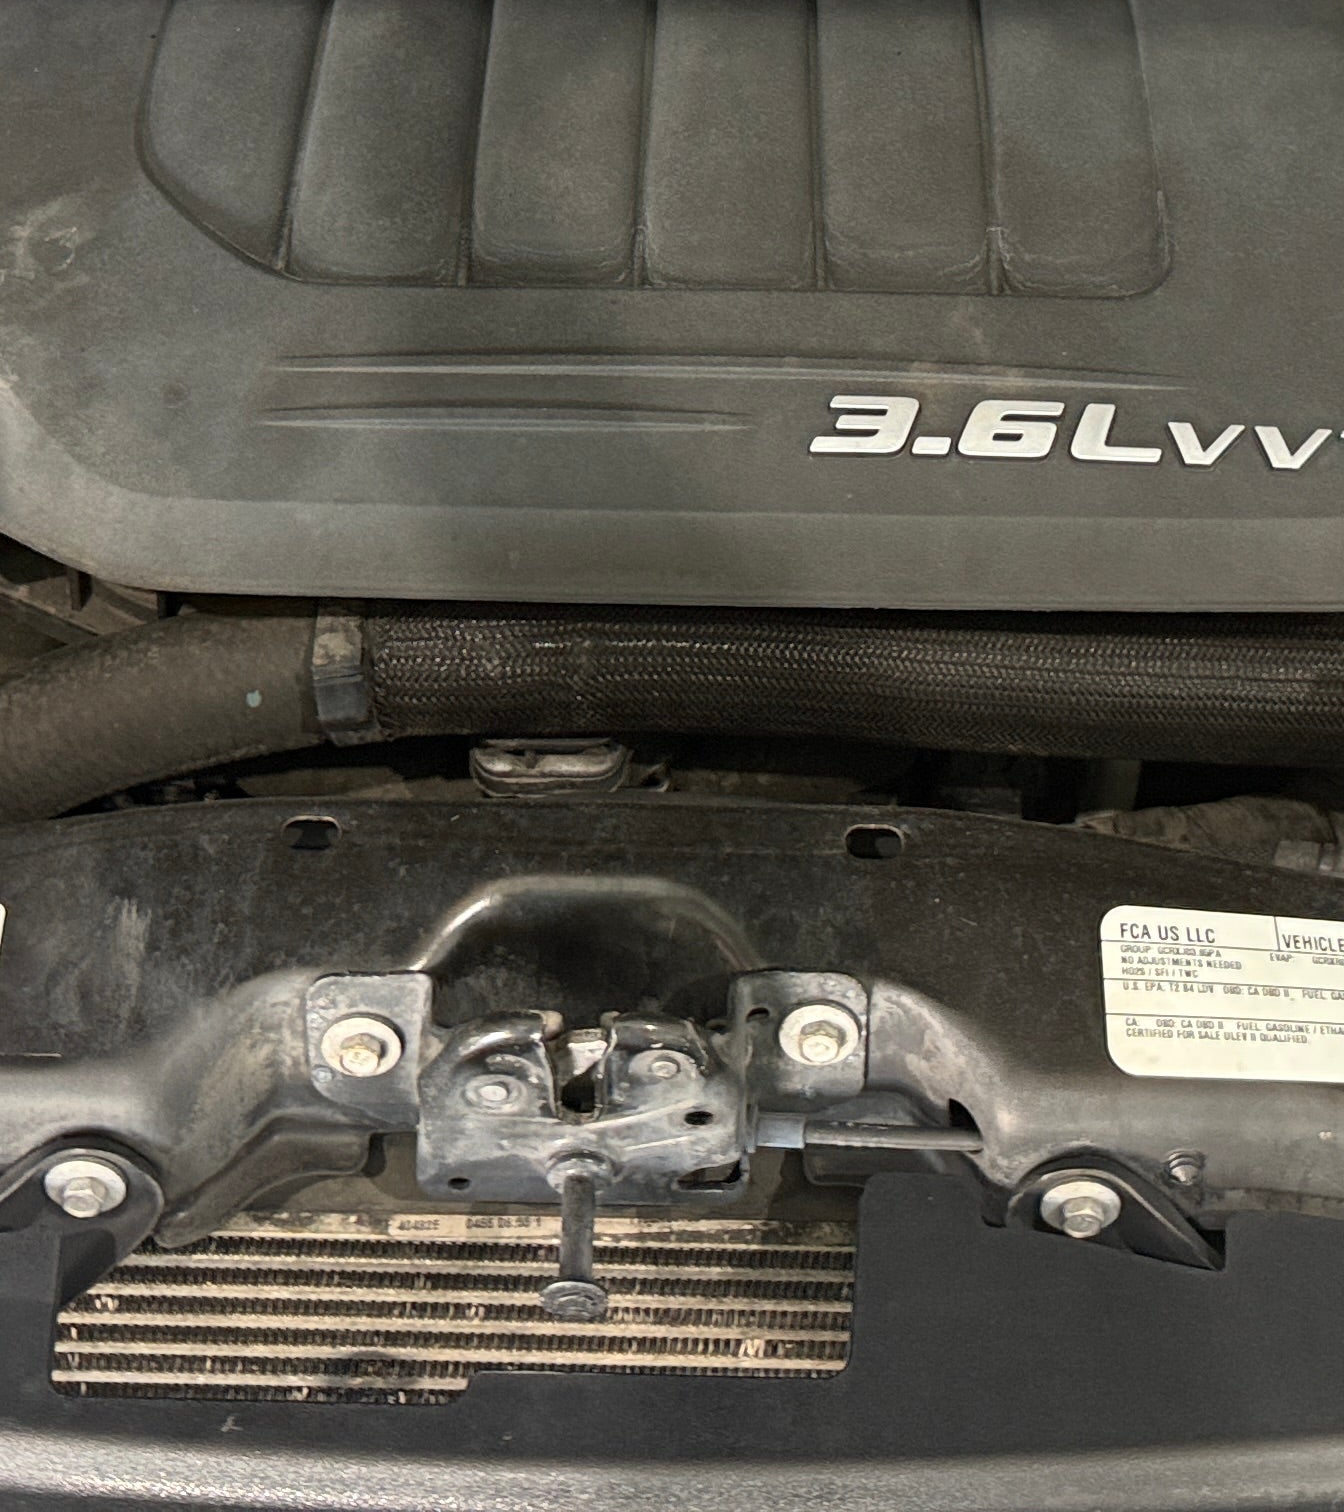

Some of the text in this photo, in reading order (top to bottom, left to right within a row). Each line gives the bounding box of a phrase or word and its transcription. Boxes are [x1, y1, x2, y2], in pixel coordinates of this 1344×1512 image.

[809, 394, 1163, 462] 3.6L
[1119, 922, 1216, 944] FCA US LLC
[1121, 956, 1243, 970] NO ADJUSTMENTS NEEDED
[1248, 986, 1260, 996] CA
[1180, 1019, 1192, 1028] CA
[1265, 1022, 1310, 1034] GASOLINE
[1126, 1028, 1174, 1038] CERTIFIED
[1177, 1030, 1195, 1039] FOR
[1198, 1030, 1221, 1040] SALE
